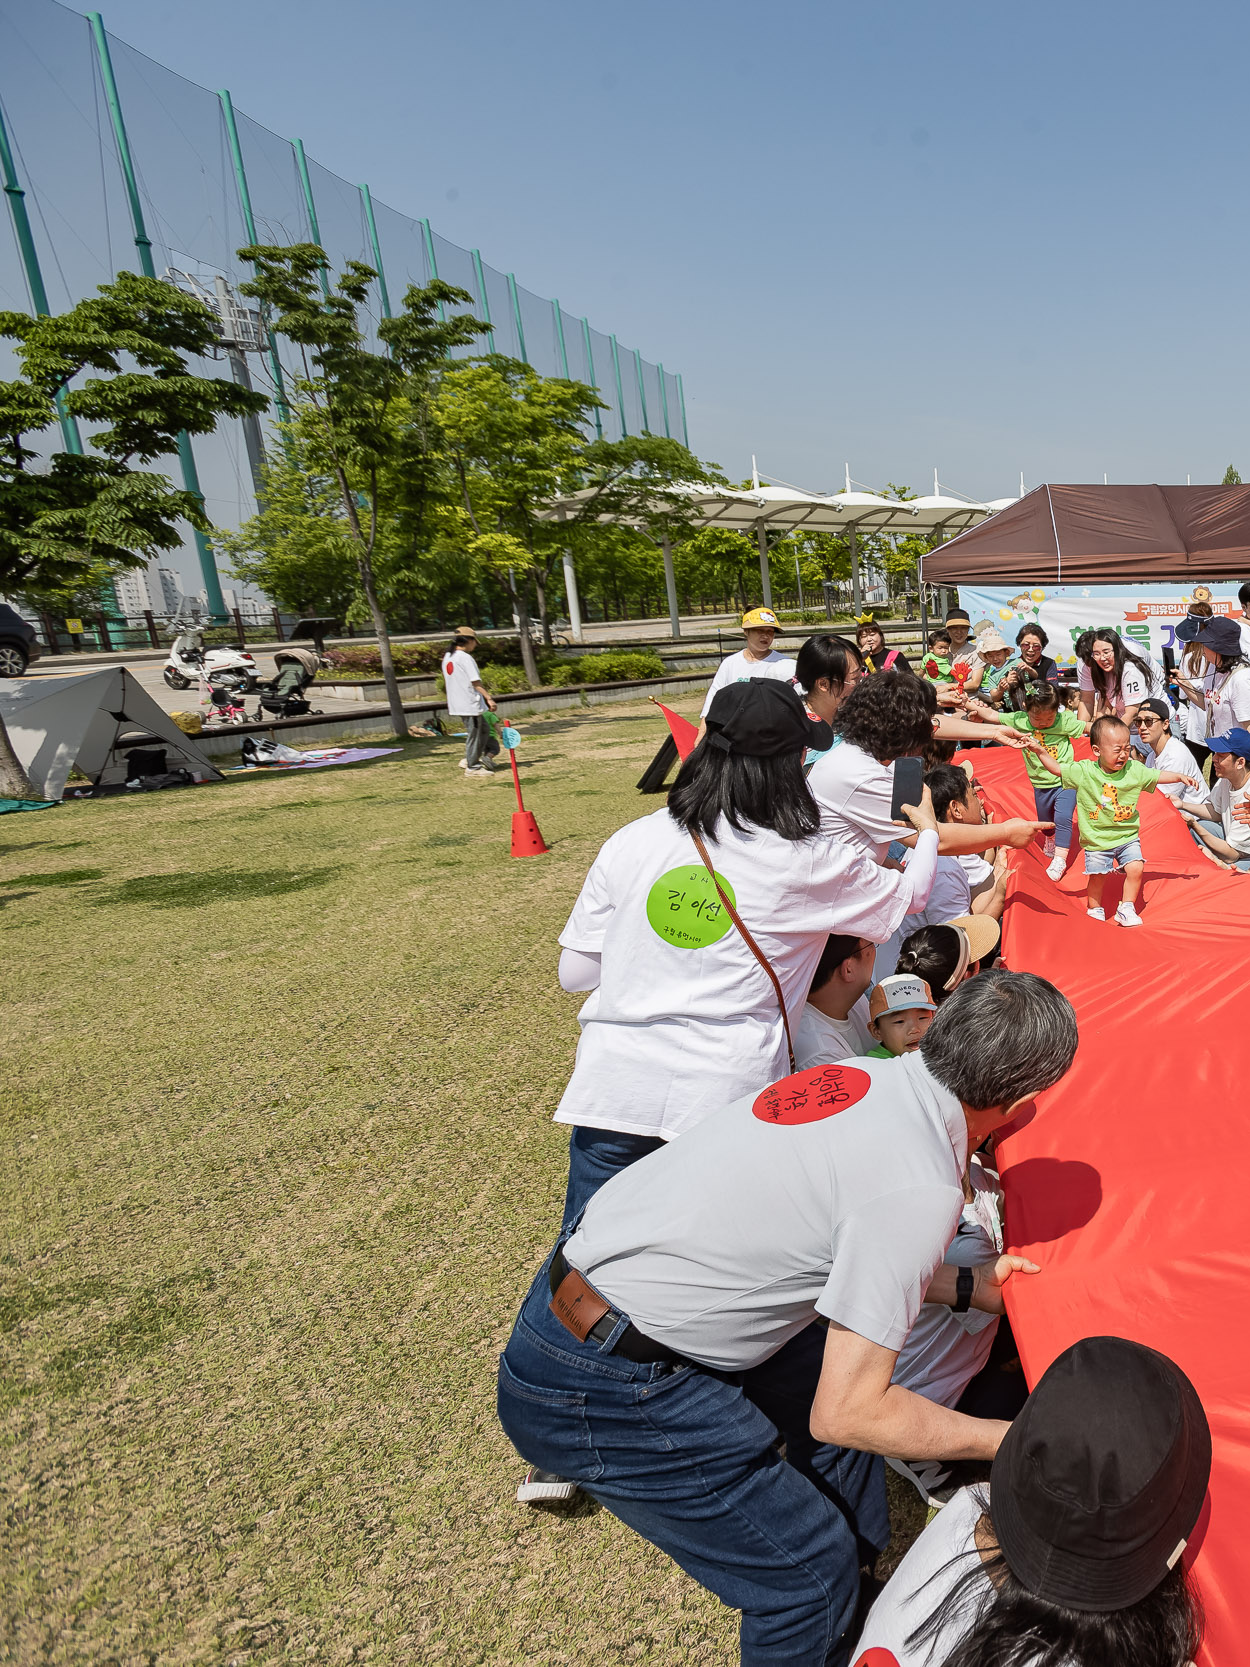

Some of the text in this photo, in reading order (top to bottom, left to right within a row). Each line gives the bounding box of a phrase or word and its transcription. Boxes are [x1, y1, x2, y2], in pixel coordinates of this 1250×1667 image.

[1126, 681, 1140, 694] 72
[892, 985, 921, 997] BLUEDOG
[783, 1088, 811, 1111] 가족
